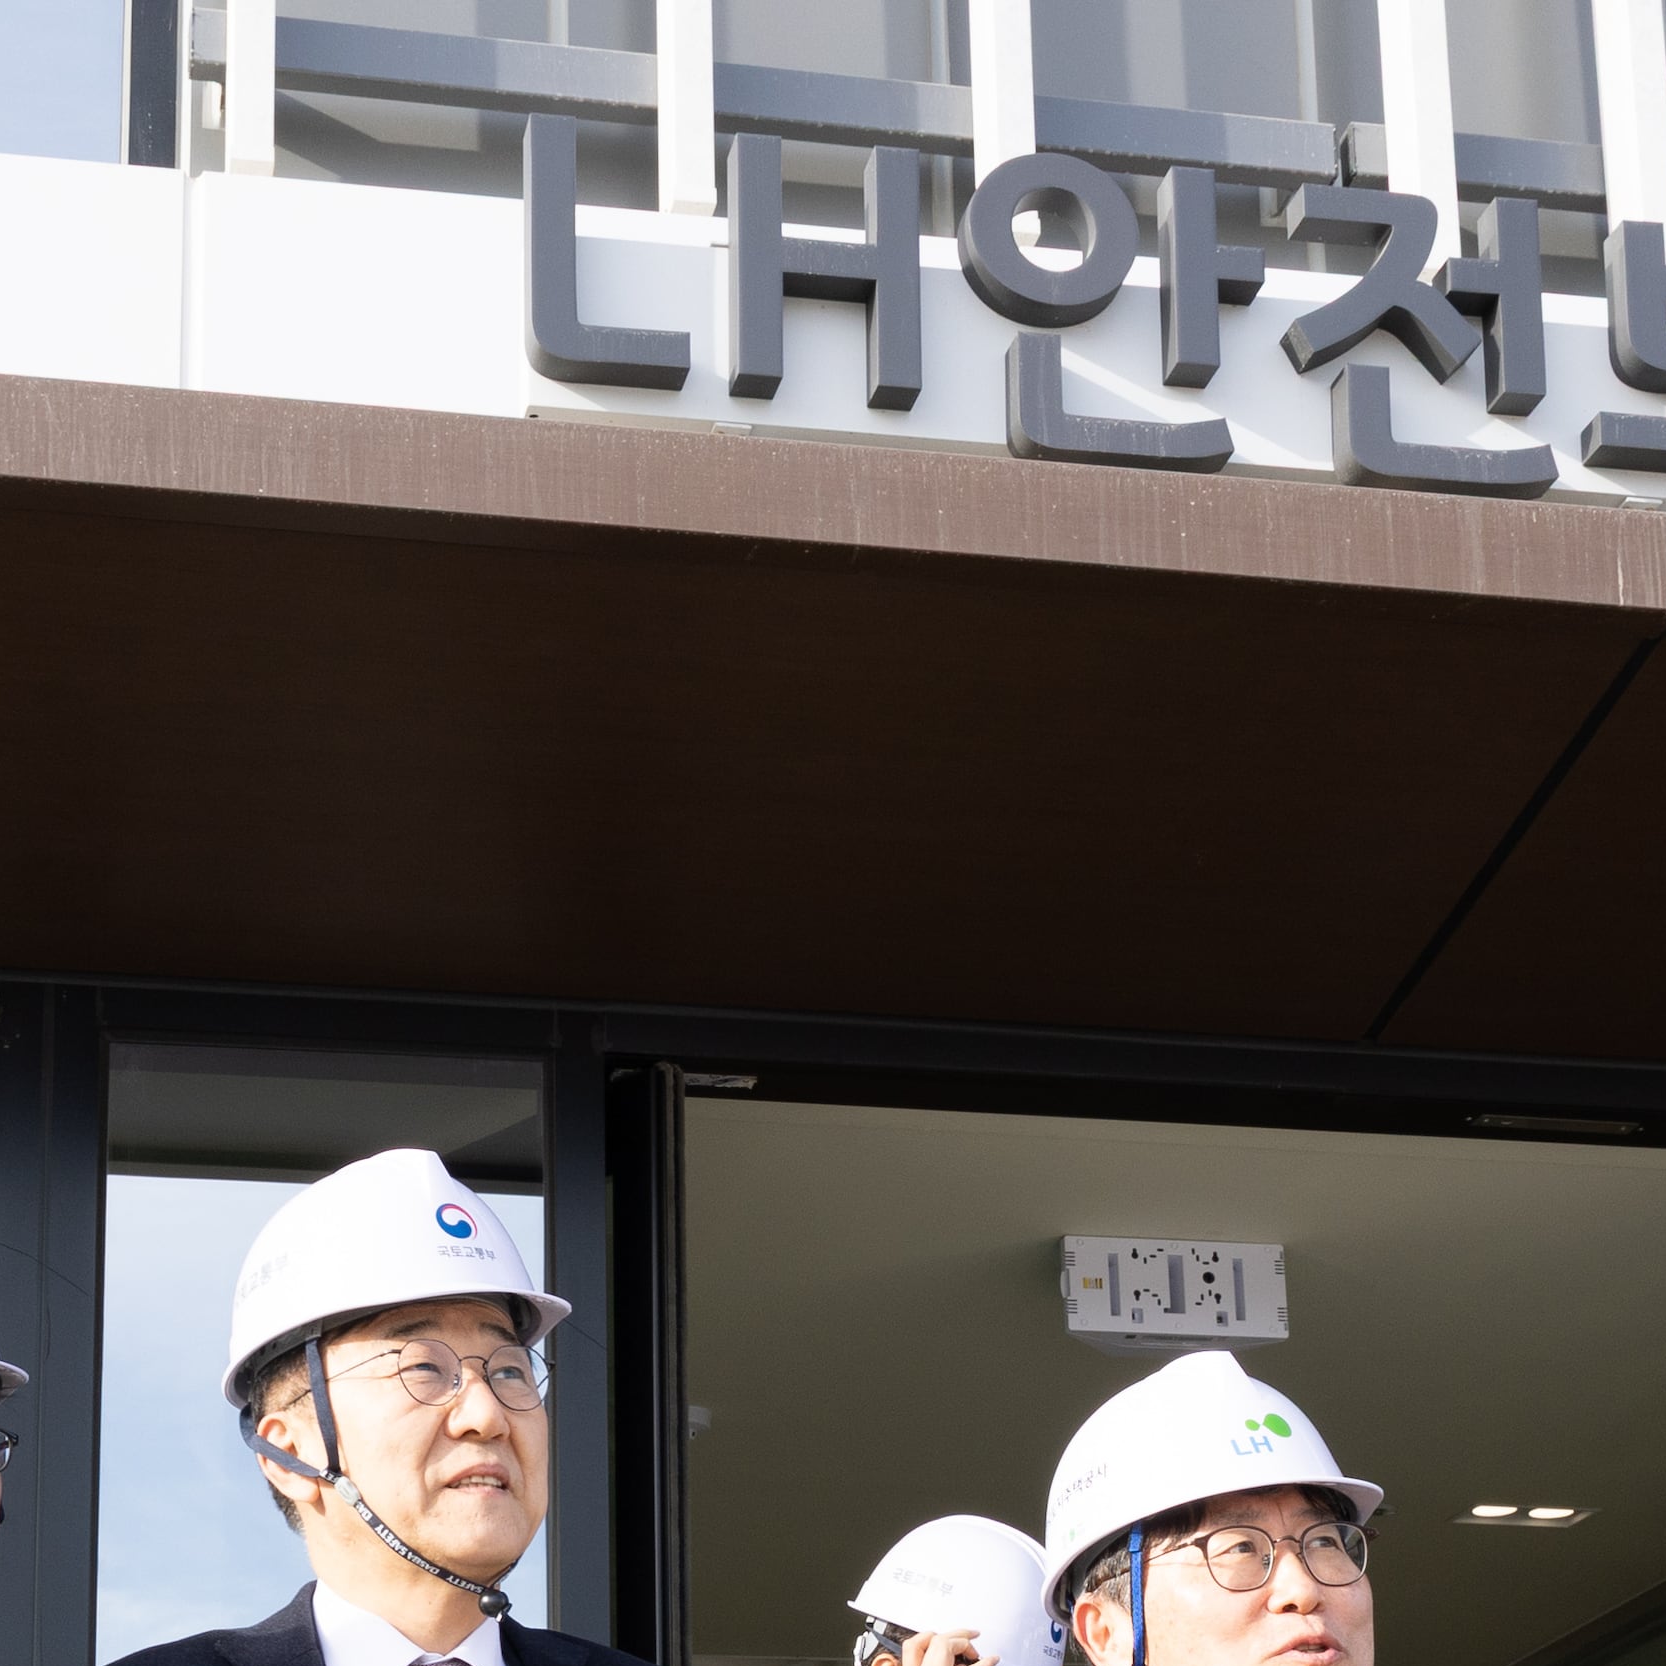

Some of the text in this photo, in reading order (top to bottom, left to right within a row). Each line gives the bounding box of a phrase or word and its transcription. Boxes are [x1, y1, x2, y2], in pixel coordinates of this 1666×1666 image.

[436, 1244, 498, 1262] 국토교통부
[1230, 1435, 1275, 1457] LH
[374, 1523, 408, 1557] SAFETY
[445, 1573, 485, 1595] SAFETY
